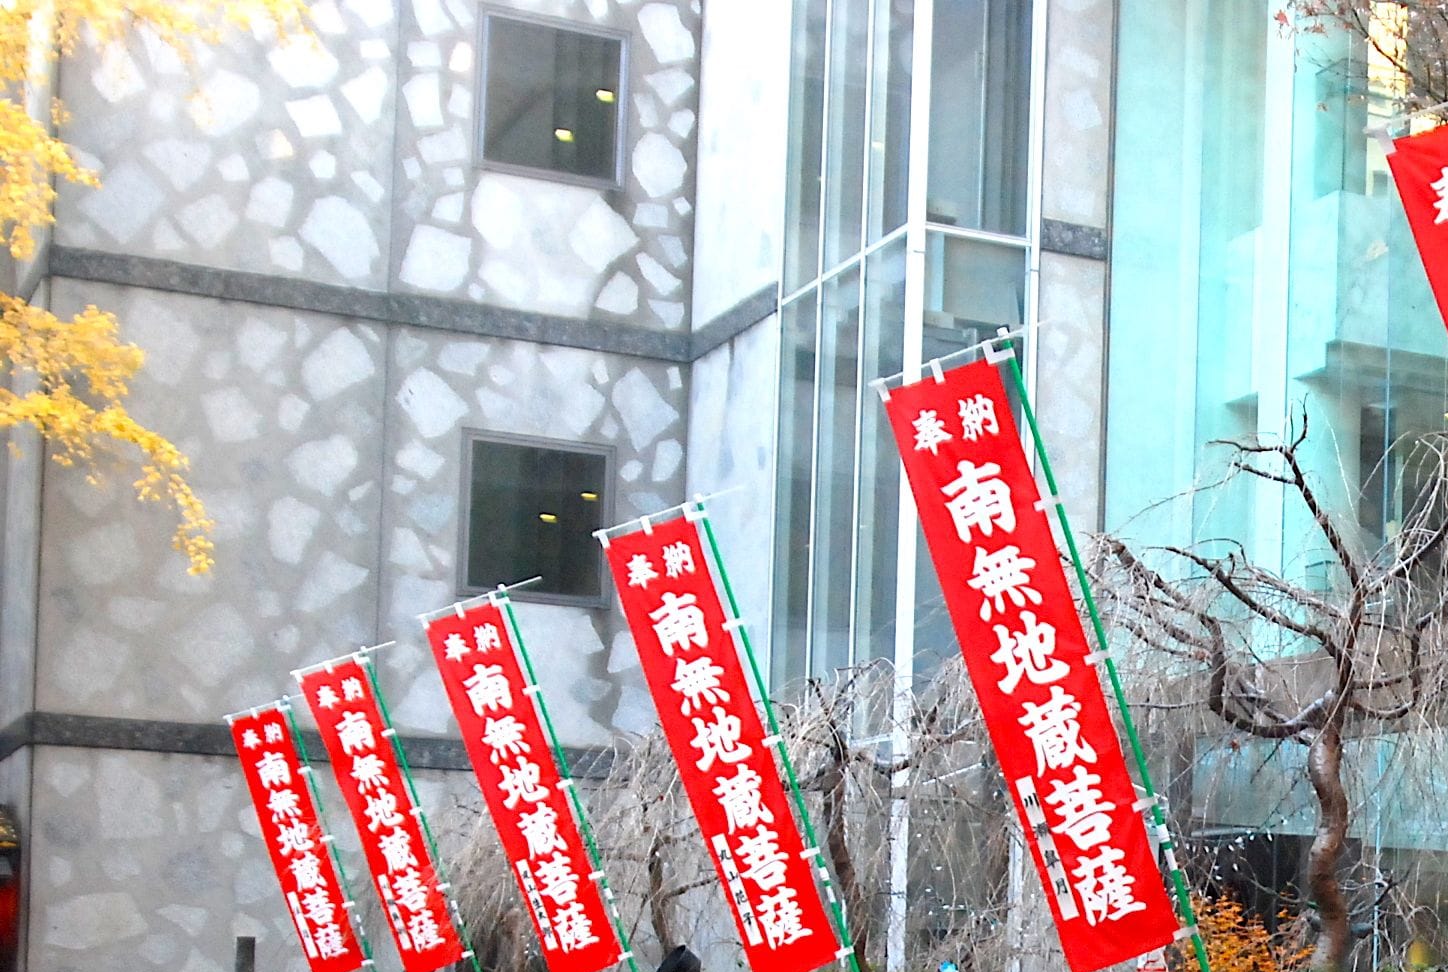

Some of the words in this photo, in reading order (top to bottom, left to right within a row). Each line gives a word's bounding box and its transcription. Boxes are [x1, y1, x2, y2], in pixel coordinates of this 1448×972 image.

[913, 393, 999, 457] 奉納
[625, 540, 697, 589] 奉納
[316, 676, 365, 709] 奉納
[443, 622, 501, 663] 奉納
[940, 459, 1147, 928] 南無地蔵菩薩
[241, 721, 283, 750] 奉納
[648, 591, 813, 950] 南無地蔵菩薩
[255, 751, 349, 960] 南無地蔵菩薩
[334, 710, 446, 953] 南無地蔵菩薩
[462, 663, 599, 955] 南無地蔵菩薩
[1023, 792, 1070, 896] 川瀬皐月
